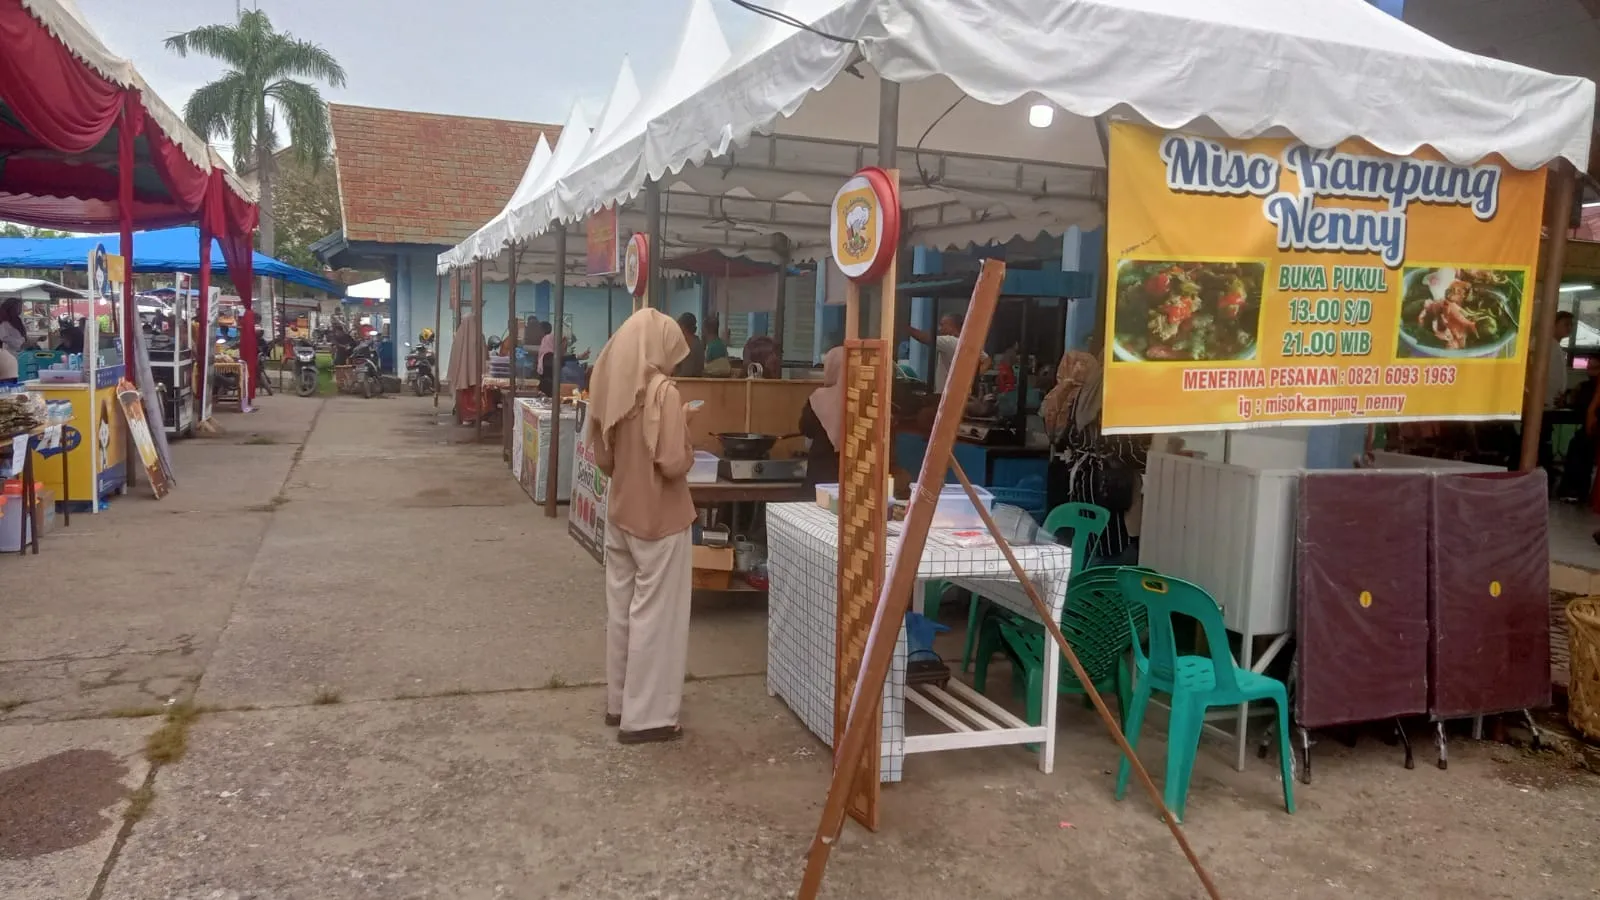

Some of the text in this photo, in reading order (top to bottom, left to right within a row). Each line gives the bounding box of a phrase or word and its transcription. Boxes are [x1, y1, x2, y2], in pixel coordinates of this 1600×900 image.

[1162, 136, 1499, 215] Miso Kampung
[1266, 195, 1405, 264] Nenny
[1279, 265, 1387, 291] BUKA PUKUL
[1289, 299, 1372, 324] 13.00 S/D
[1282, 332, 1371, 355] 21.00 WIB
[1184, 368, 1265, 390] MENERIMA
[1348, 368, 1379, 385] 0821
[1385, 368, 1419, 385] 6093
[1424, 367, 1456, 384] 1963
[1238, 397, 1251, 417] ig
[1265, 394, 1405, 416] misokampung_nenny
